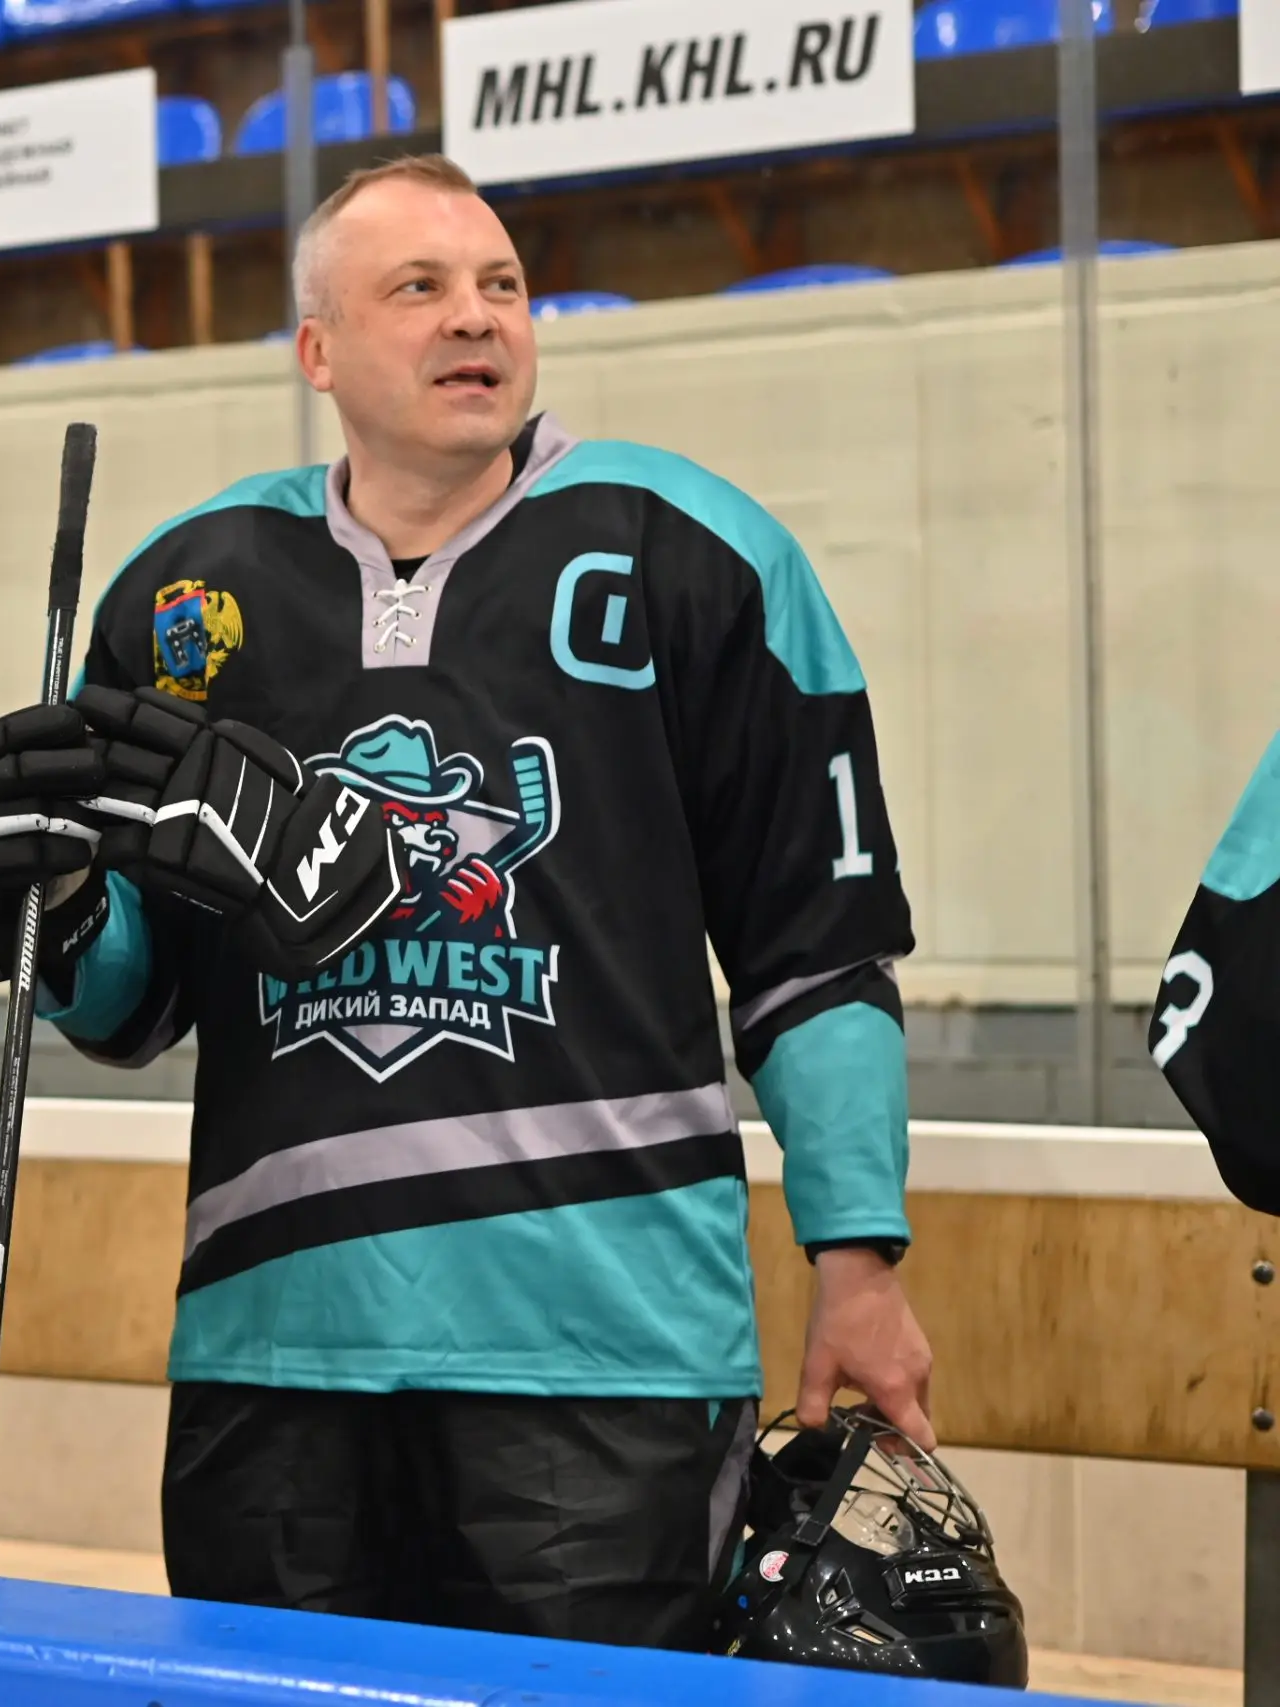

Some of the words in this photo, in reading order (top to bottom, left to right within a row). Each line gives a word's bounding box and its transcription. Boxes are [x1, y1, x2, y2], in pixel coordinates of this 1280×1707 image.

[472, 13, 880, 130] MHL.KHL.RU
[384, 939, 544, 1006] WEST
[295, 990, 381, 1030] ДИКИЙ
[389, 994, 491, 1030] ЗАПАД
[905, 1567, 962, 1584] CCM
